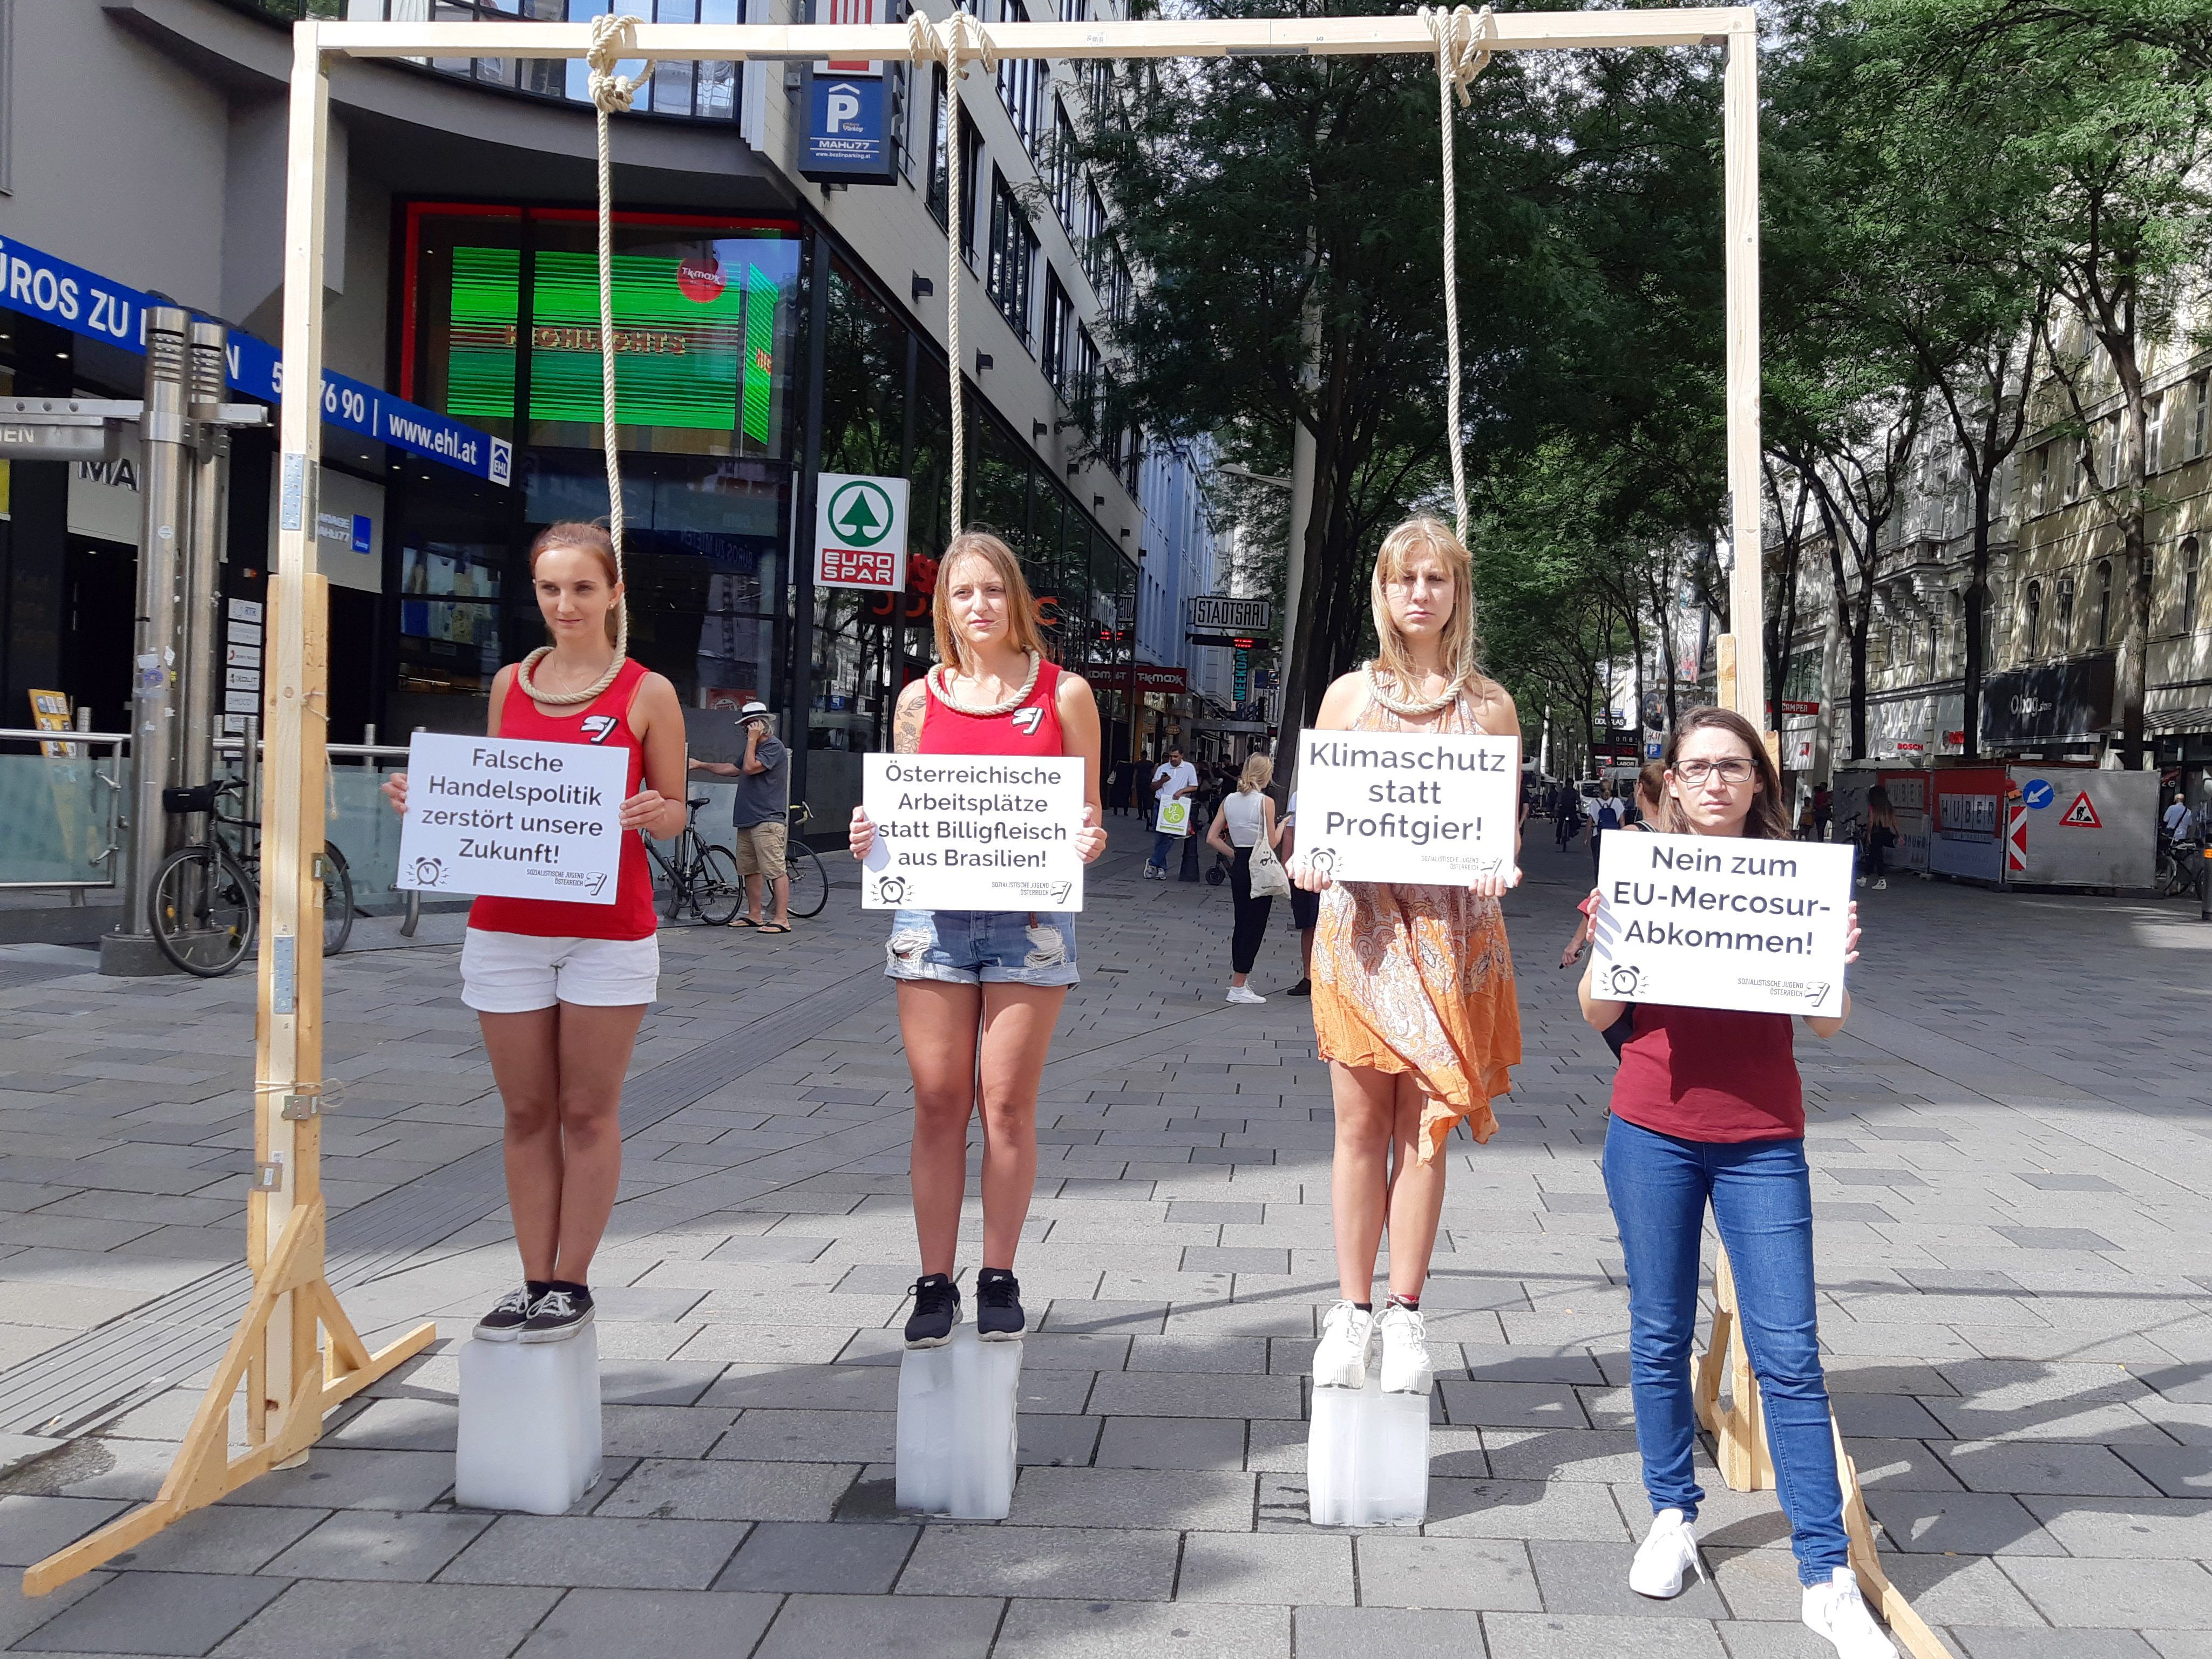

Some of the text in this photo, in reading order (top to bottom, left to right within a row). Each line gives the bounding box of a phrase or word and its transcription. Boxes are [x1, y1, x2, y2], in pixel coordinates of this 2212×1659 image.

[826, 94, 859, 133] P
[88, 288, 128, 337] ZU
[342, 389, 365, 423] 90
[389, 413, 477, 465] www.ehl.at
[494, 461, 507, 477] EHL
[824, 552, 893, 568] EURO
[823, 567, 891, 583] SPAR
[1198, 600, 1266, 627] STADTSAAL
[1233, 648, 1249, 701] WEEKDAY
[1782, 703, 1808, 712] CAMPER
[1310, 742, 1506, 772] Klimaschutz
[1897, 743, 1923, 751] BOSCH
[472, 748, 564, 772] Falsche
[885, 760, 1061, 785] Österreichische
[429, 775, 602, 806] Handelspolitik
[1368, 779, 1442, 804] statt
[898, 793, 1048, 815] Arbeitsplätze
[1942, 800, 1994, 825] HUBER
[421, 809, 603, 837] zerstört unsere
[878, 820, 1067, 844] statt Billigfleisch
[1326, 811, 1482, 846] Profitgier!
[458, 838, 560, 864] Zukunft!
[898, 849, 1047, 868] aus Brasilien!
[1652, 846, 1797, 878] Nein zum
[526, 869, 584, 879] SOZIALISTISCHE JUGEND
[554, 877, 583, 887] ÖSTERREICH
[1020, 888, 1049, 896] ÖSTERREICH
[1613, 881, 1830, 917] EU-Mercosur-
[1624, 920, 1813, 955] Abkommen!
[1738, 978, 1804, 989] SOZIALISTISCHE JUGEND
[1770, 987, 1803, 997] ÖSTERREICH
